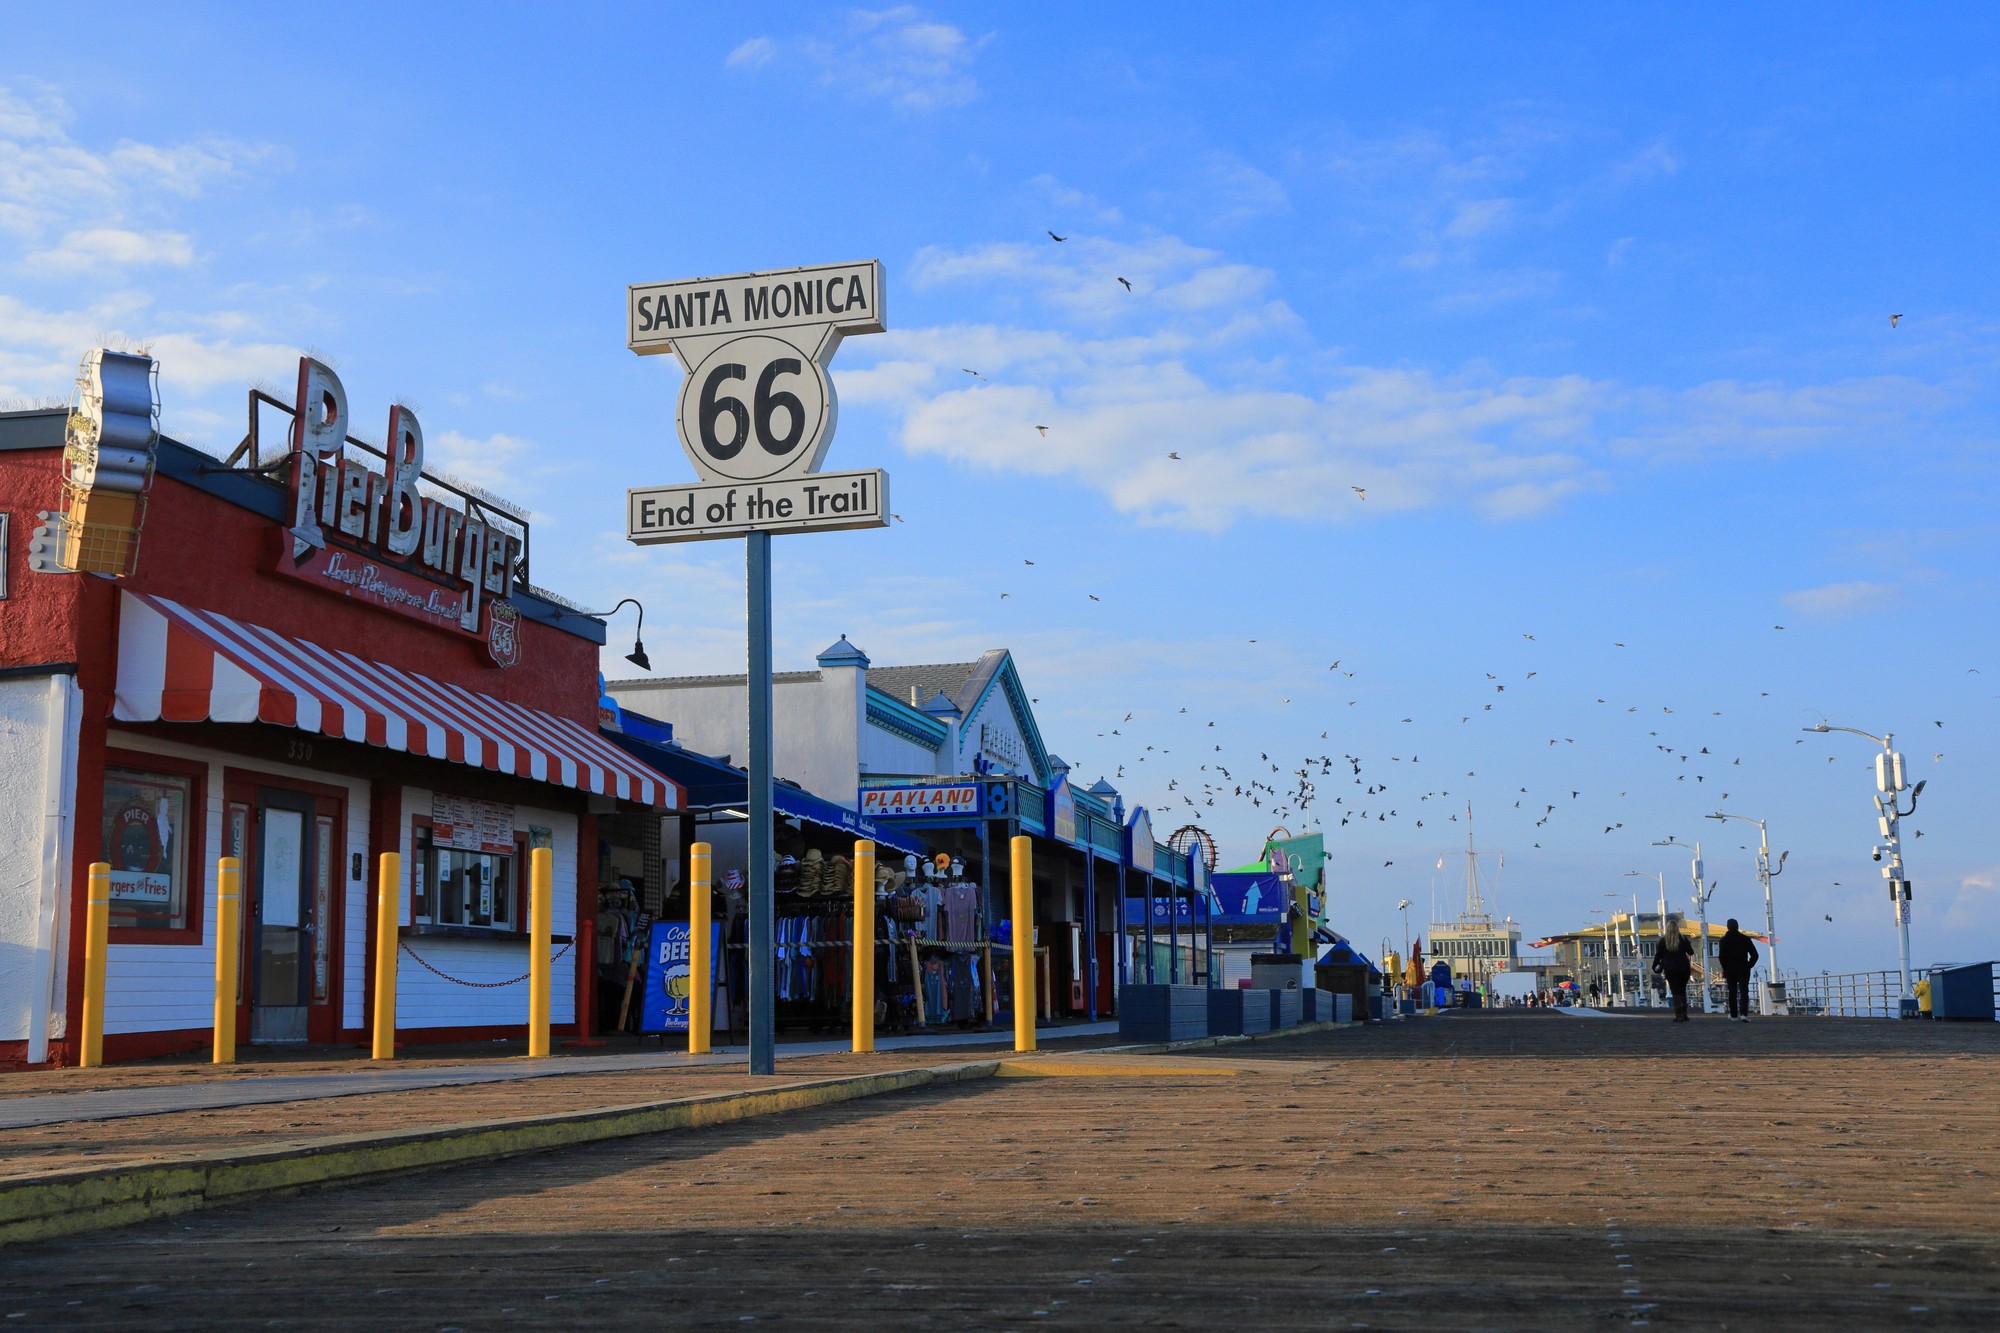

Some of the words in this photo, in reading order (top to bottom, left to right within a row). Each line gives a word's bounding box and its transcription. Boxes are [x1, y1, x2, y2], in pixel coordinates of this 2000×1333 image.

[638, 289, 732, 332] SANTA
[744, 274, 867, 322] MONICA
[699, 357, 806, 461] 66
[641, 493, 694, 528] End
[706, 489, 737, 522] of
[746, 487, 793, 520] the
[803, 478, 867, 515] Trail
[288, 740, 313, 760] 330
[864, 788, 974, 807] PLAYLAND
[123, 808, 149, 824] PIER
[881, 805, 958, 814] ARCADE
[319, 827, 328, 887] CONES
[110, 880, 136, 897] rgers
[144, 877, 168, 896] Fries
[667, 926, 690, 940] Col
[315, 905, 327, 987] SUNDAES
[660, 942, 690, 964] BEE
